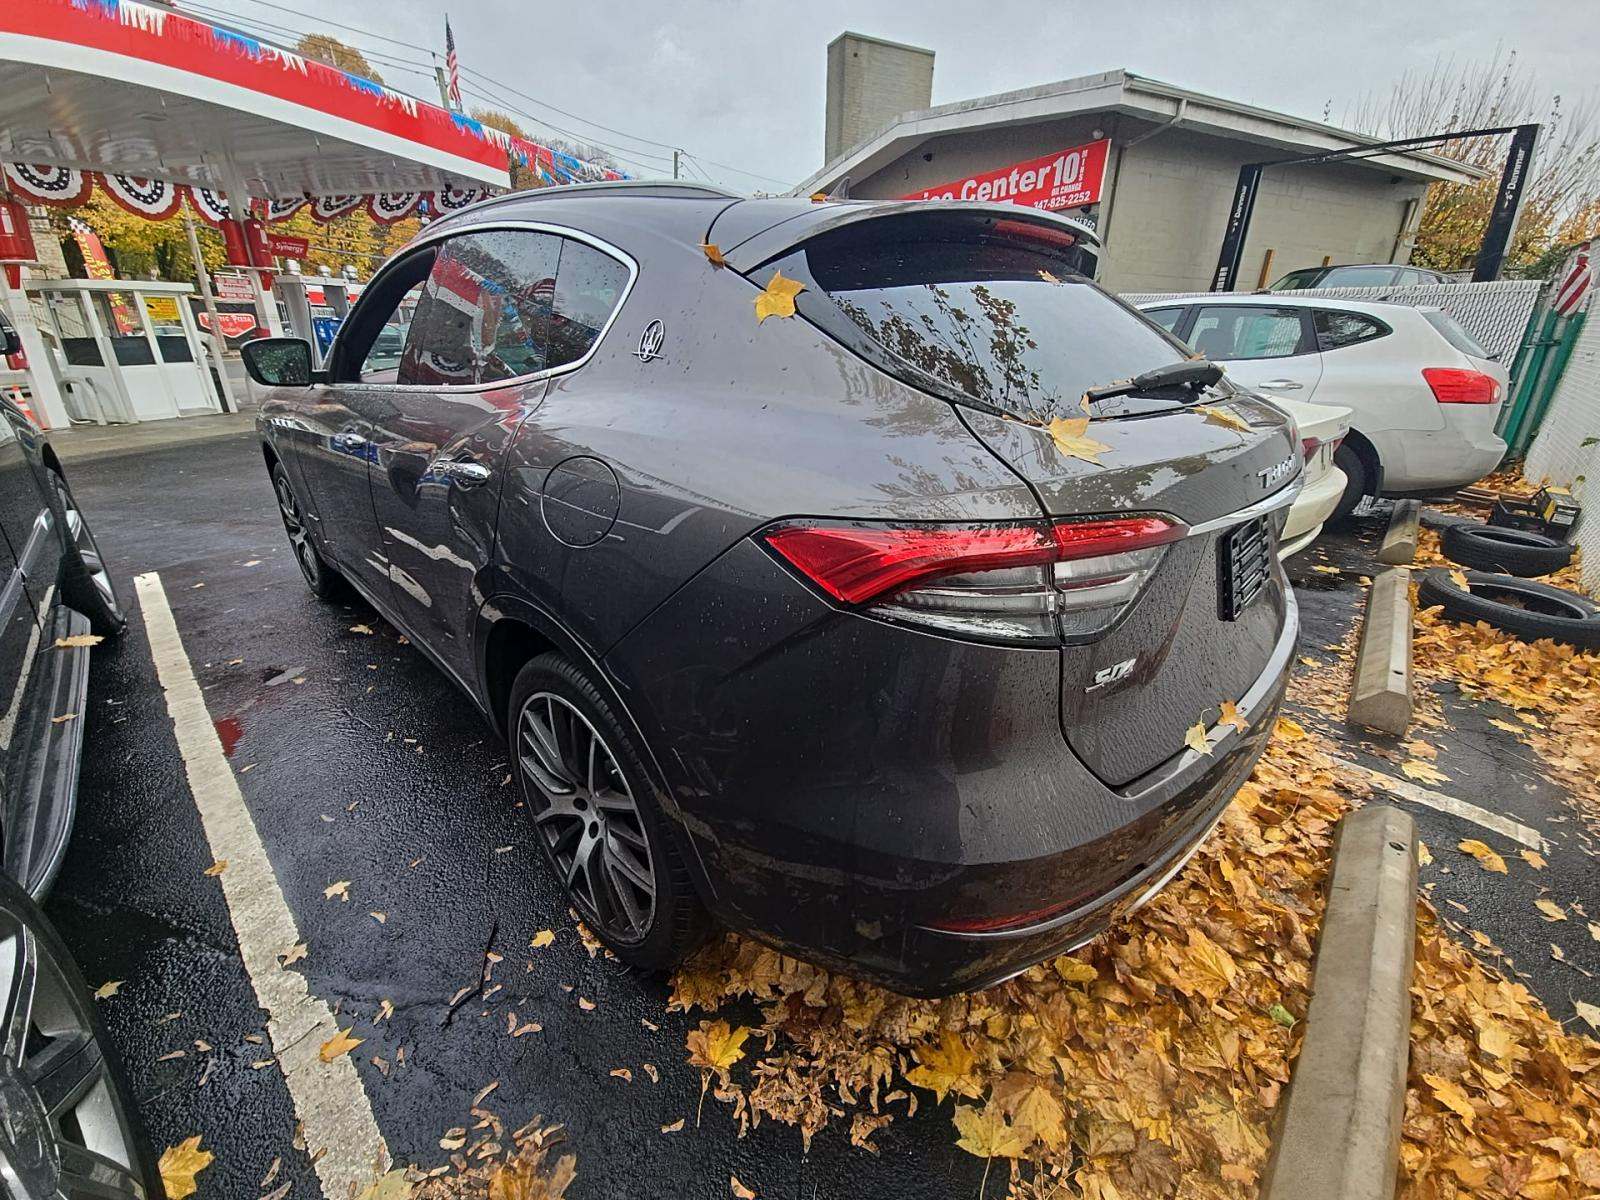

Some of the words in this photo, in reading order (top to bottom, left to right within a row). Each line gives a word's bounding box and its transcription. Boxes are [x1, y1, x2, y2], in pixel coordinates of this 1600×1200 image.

[1053, 152, 1081, 187] 10
[961, 164, 1051, 202] Center
[1060, 182, 1083, 195] CHANGE
[275, 242, 305, 254] Synergy
